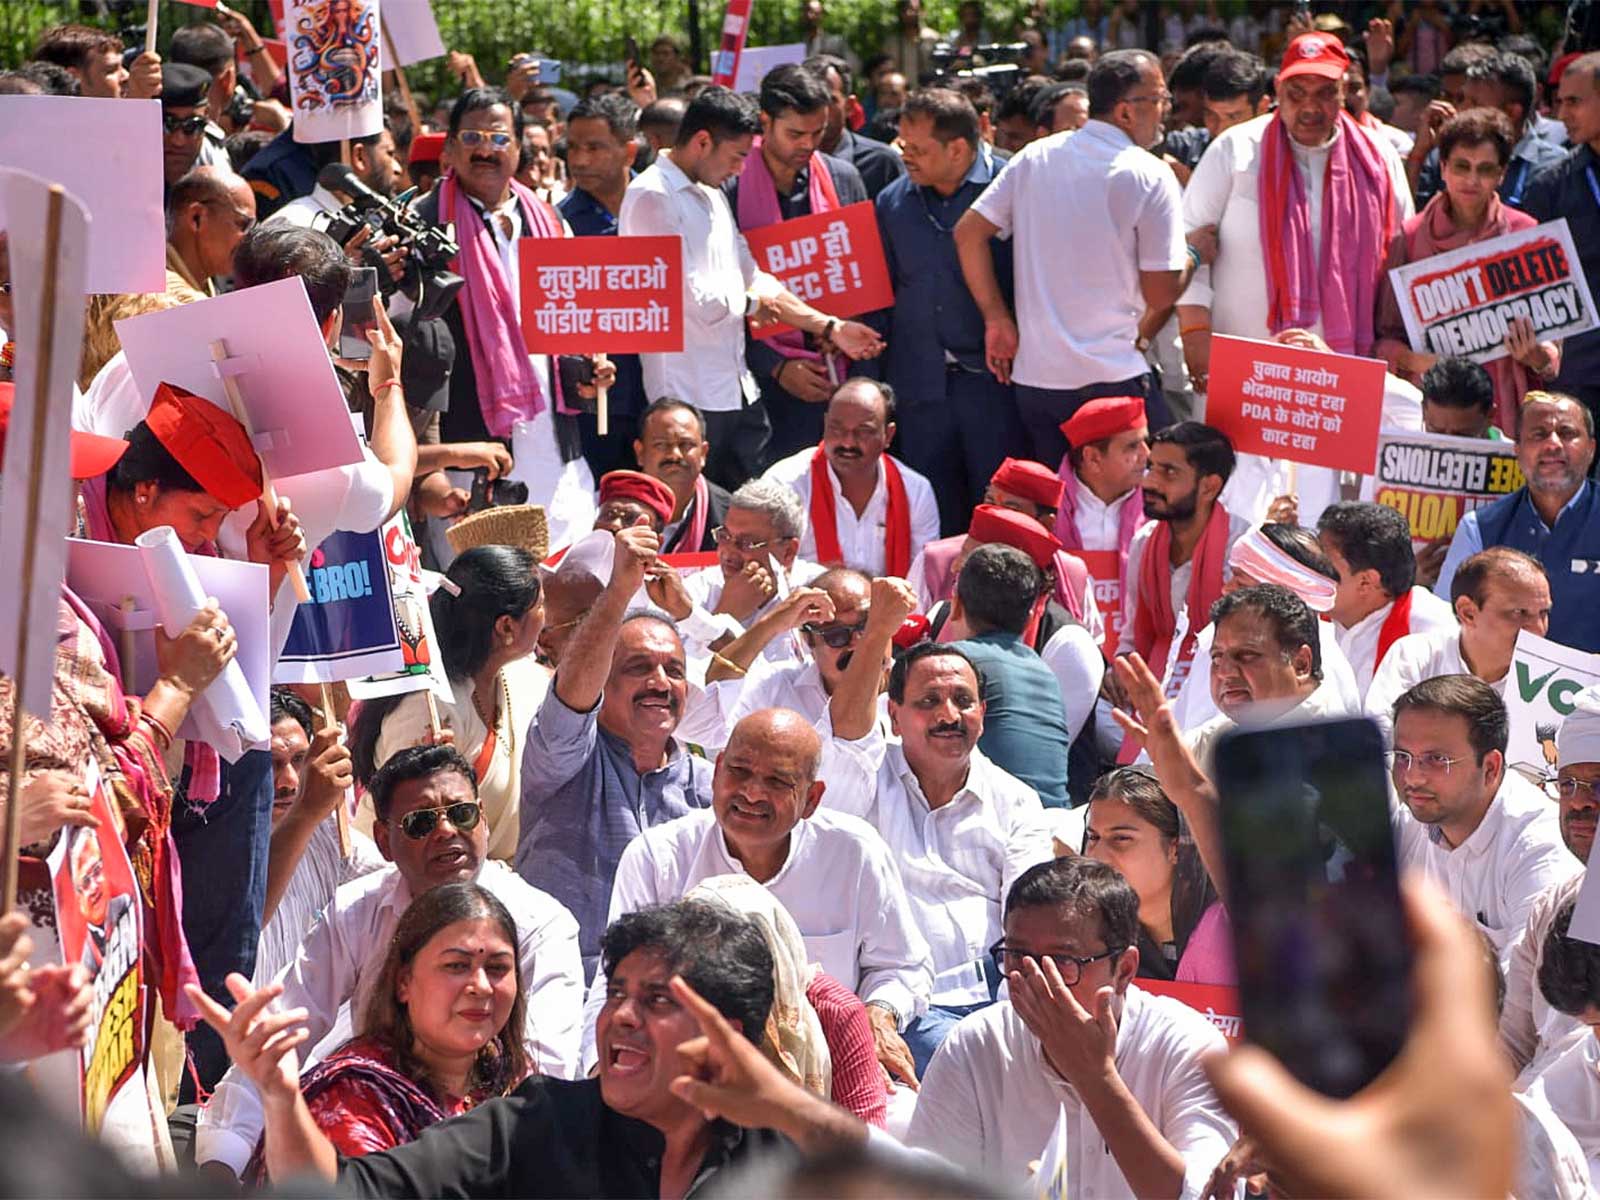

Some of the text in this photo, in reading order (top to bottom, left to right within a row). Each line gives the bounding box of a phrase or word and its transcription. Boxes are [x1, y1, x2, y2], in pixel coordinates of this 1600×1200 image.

[766, 220, 851, 273] BJP ही
[537, 257, 668, 300] मुचुआ हटाओ
[1414, 243, 1569, 321] DON'T DELETE
[534, 300, 670, 334] पीडीए बचाओ!
[1253, 361, 1339, 388] चुनाव आयोग
[1242, 378, 1346, 412] भेदभाव कर रहा
[1242, 403, 1271, 421] PDA
[1275, 405, 1289, 423] के
[1322, 414, 1343, 433] को
[1262, 428, 1317, 450] काट रहा
[1382, 445, 1488, 491] ELECTIONS
[313, 561, 372, 603] BRO!
